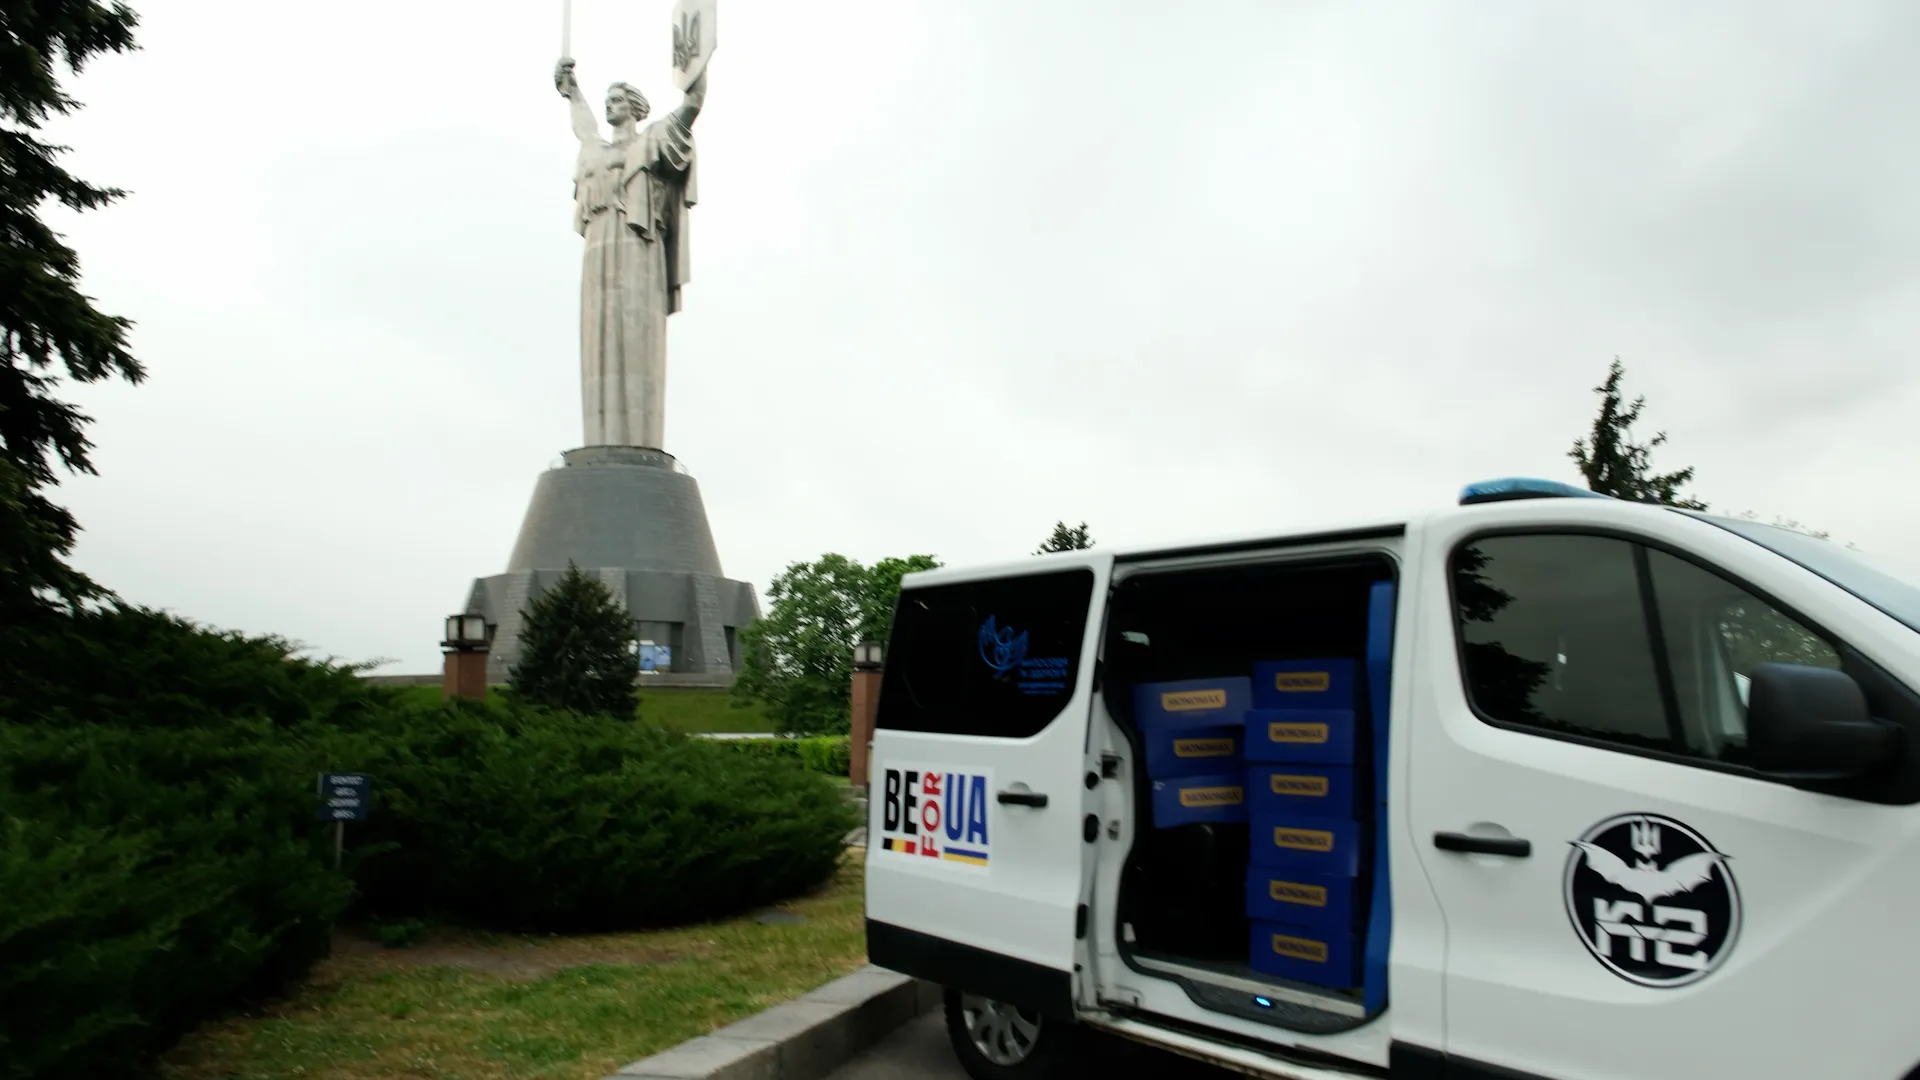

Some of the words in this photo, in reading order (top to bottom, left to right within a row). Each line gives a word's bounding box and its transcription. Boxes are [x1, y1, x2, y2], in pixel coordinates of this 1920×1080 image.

[884, 768, 919, 835] BE
[921, 772, 942, 858] FOR
[945, 773, 989, 845] UA
